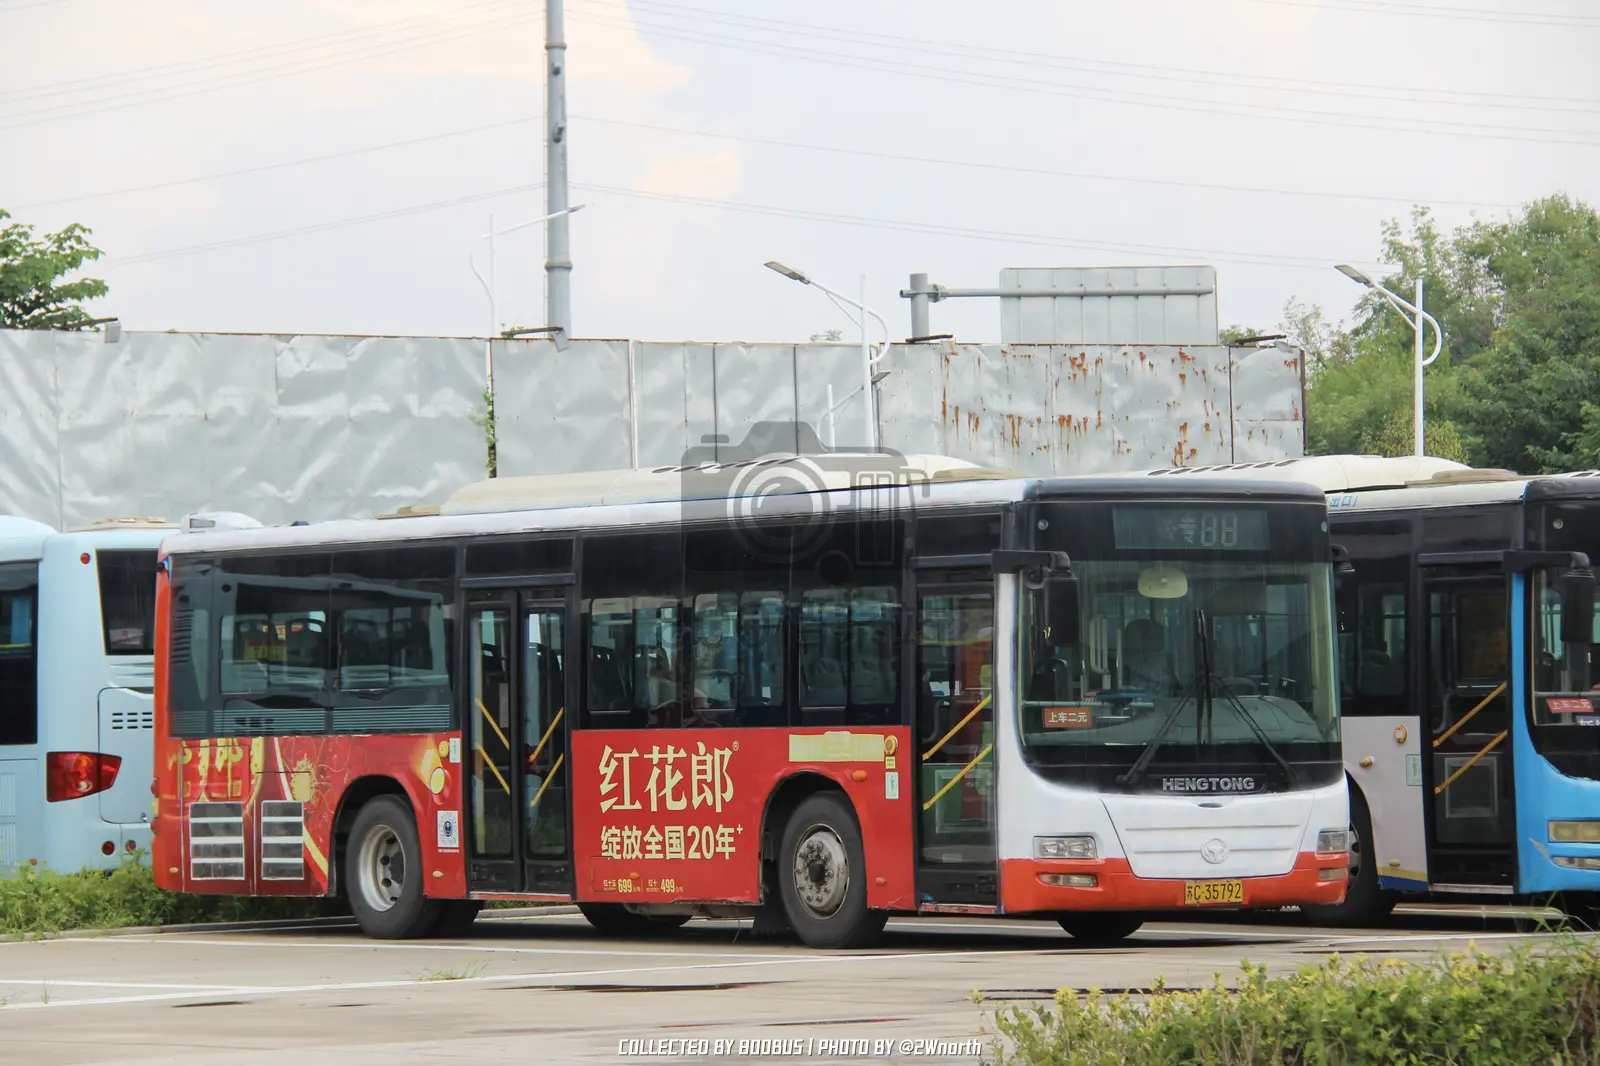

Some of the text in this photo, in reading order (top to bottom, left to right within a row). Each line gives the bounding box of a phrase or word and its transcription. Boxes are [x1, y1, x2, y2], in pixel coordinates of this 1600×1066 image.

[1048, 711, 1088, 724] 上车二元
[1162, 777, 1255, 791] HENGTONG
[618, 879, 633, 893] 699
[661, 879, 675, 893] 499
